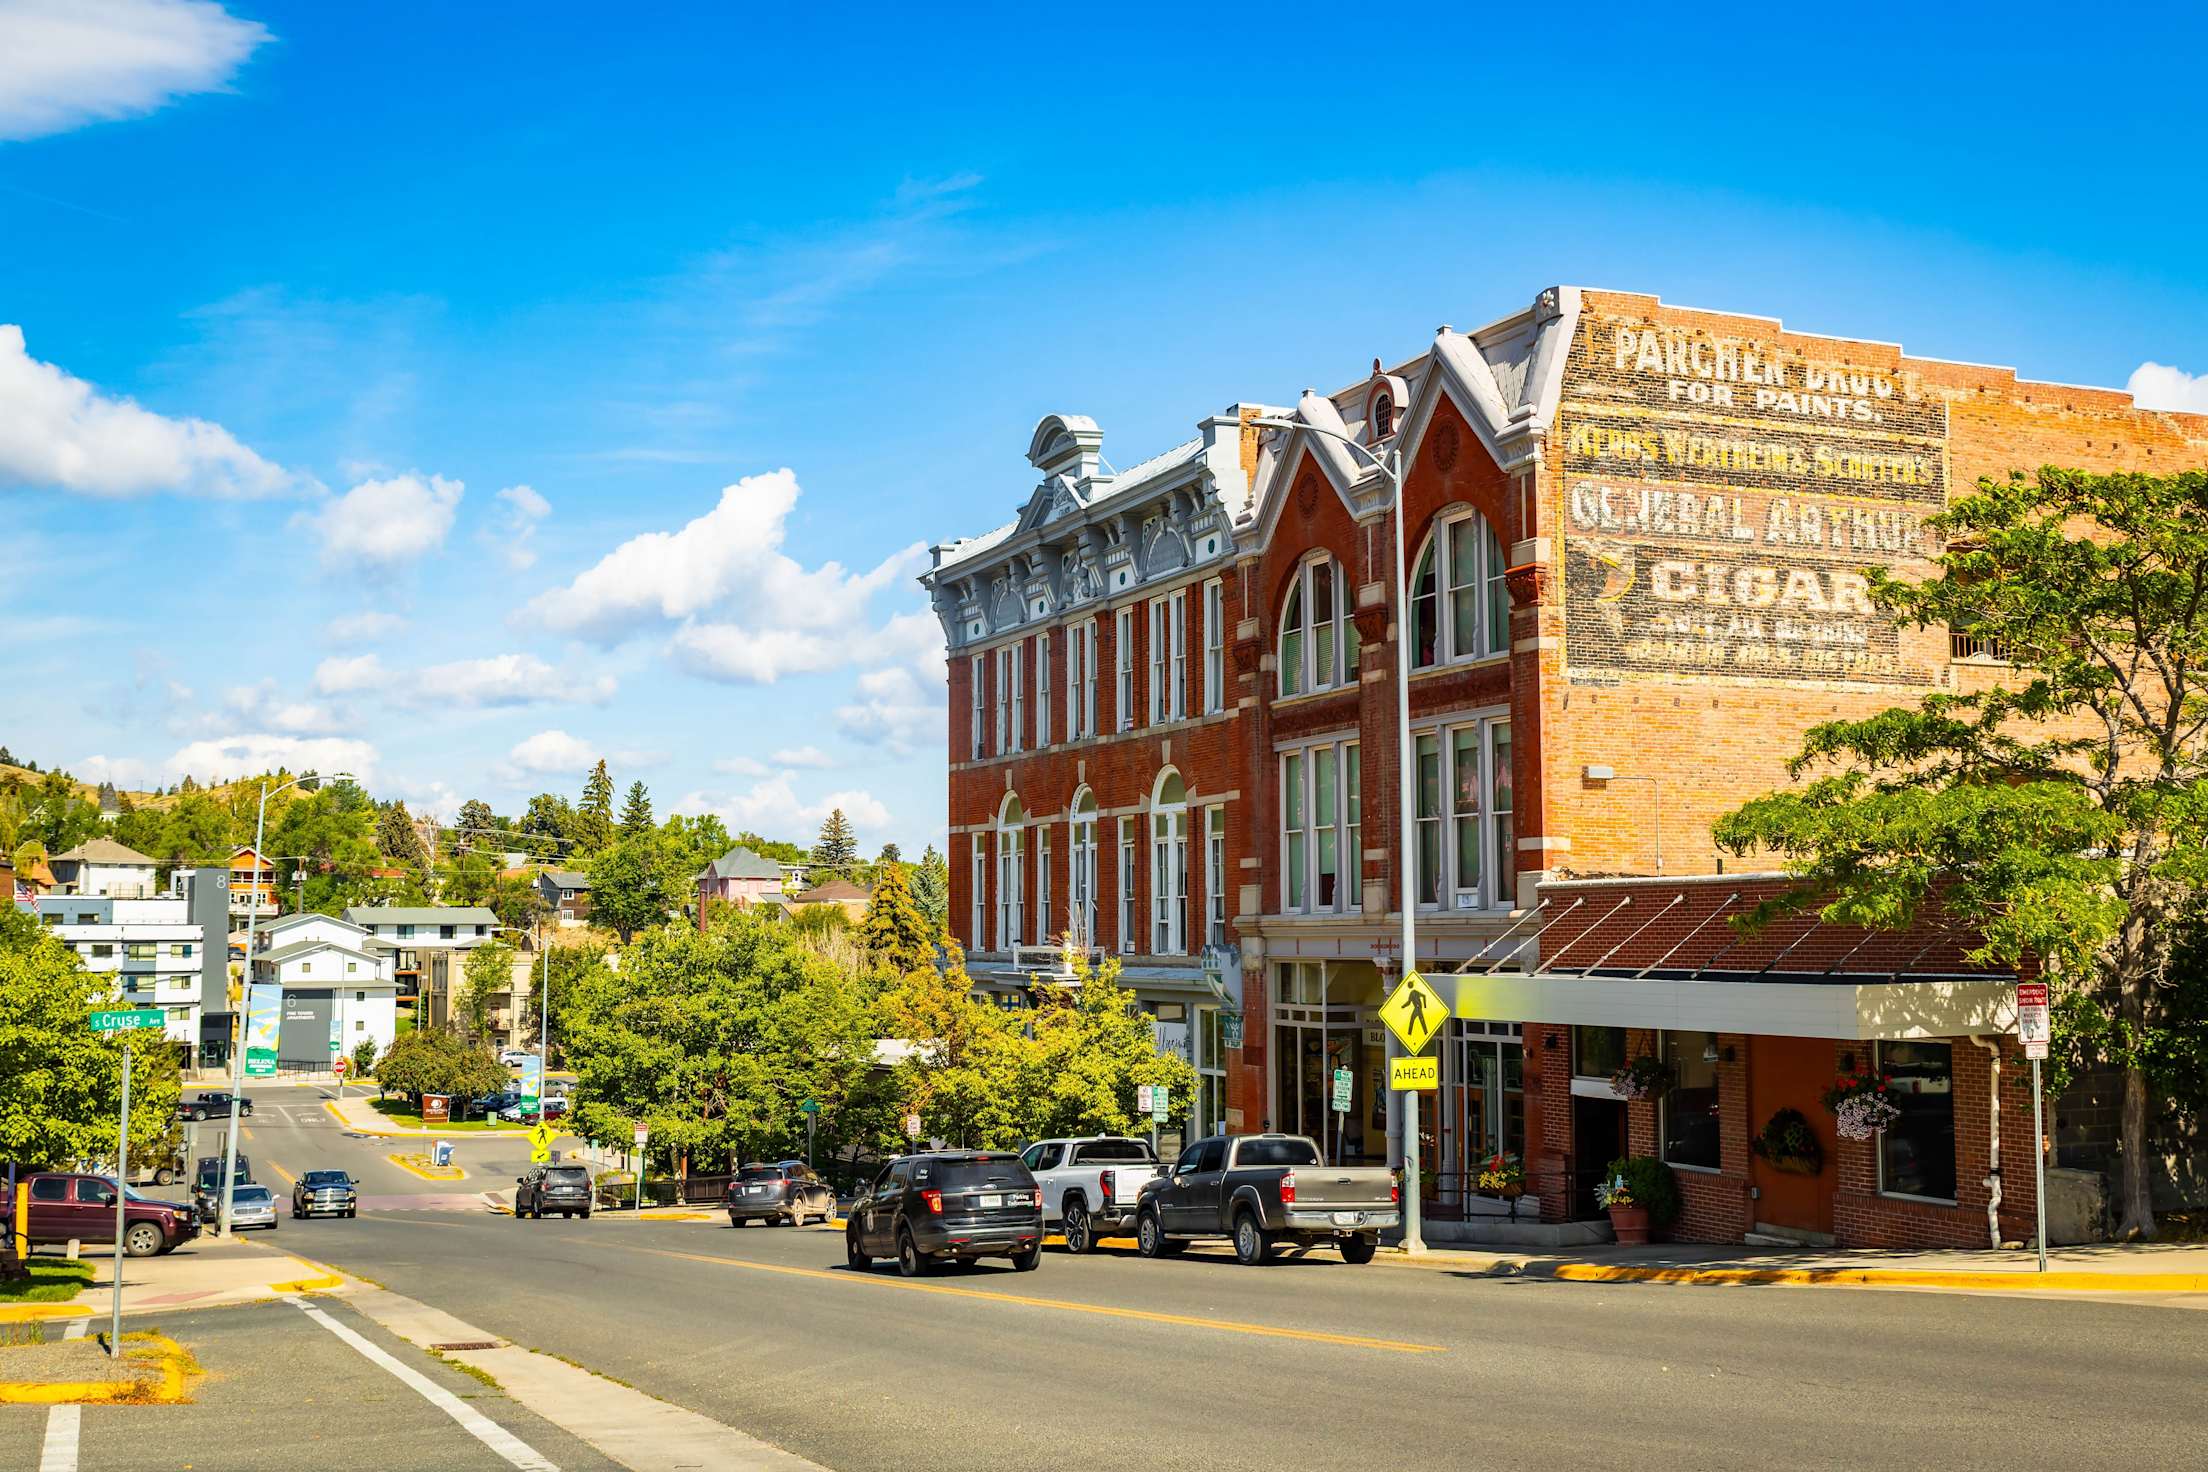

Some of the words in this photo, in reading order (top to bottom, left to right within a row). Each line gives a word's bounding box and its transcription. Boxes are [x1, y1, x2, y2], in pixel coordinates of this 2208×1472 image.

[1668, 379, 1734, 407] FOR
[1756, 388, 1882, 422] PAINTS.
[1570, 479, 1755, 539] GENERAL
[1650, 560, 1876, 614] CIGAR
[216, 874, 226, 889] 8
[286, 993, 297, 1008] 6
[94, 1019, 100, 1027] S
[102, 1013, 141, 1027] Cruse
[1394, 1067, 1435, 1080] AHEAD
